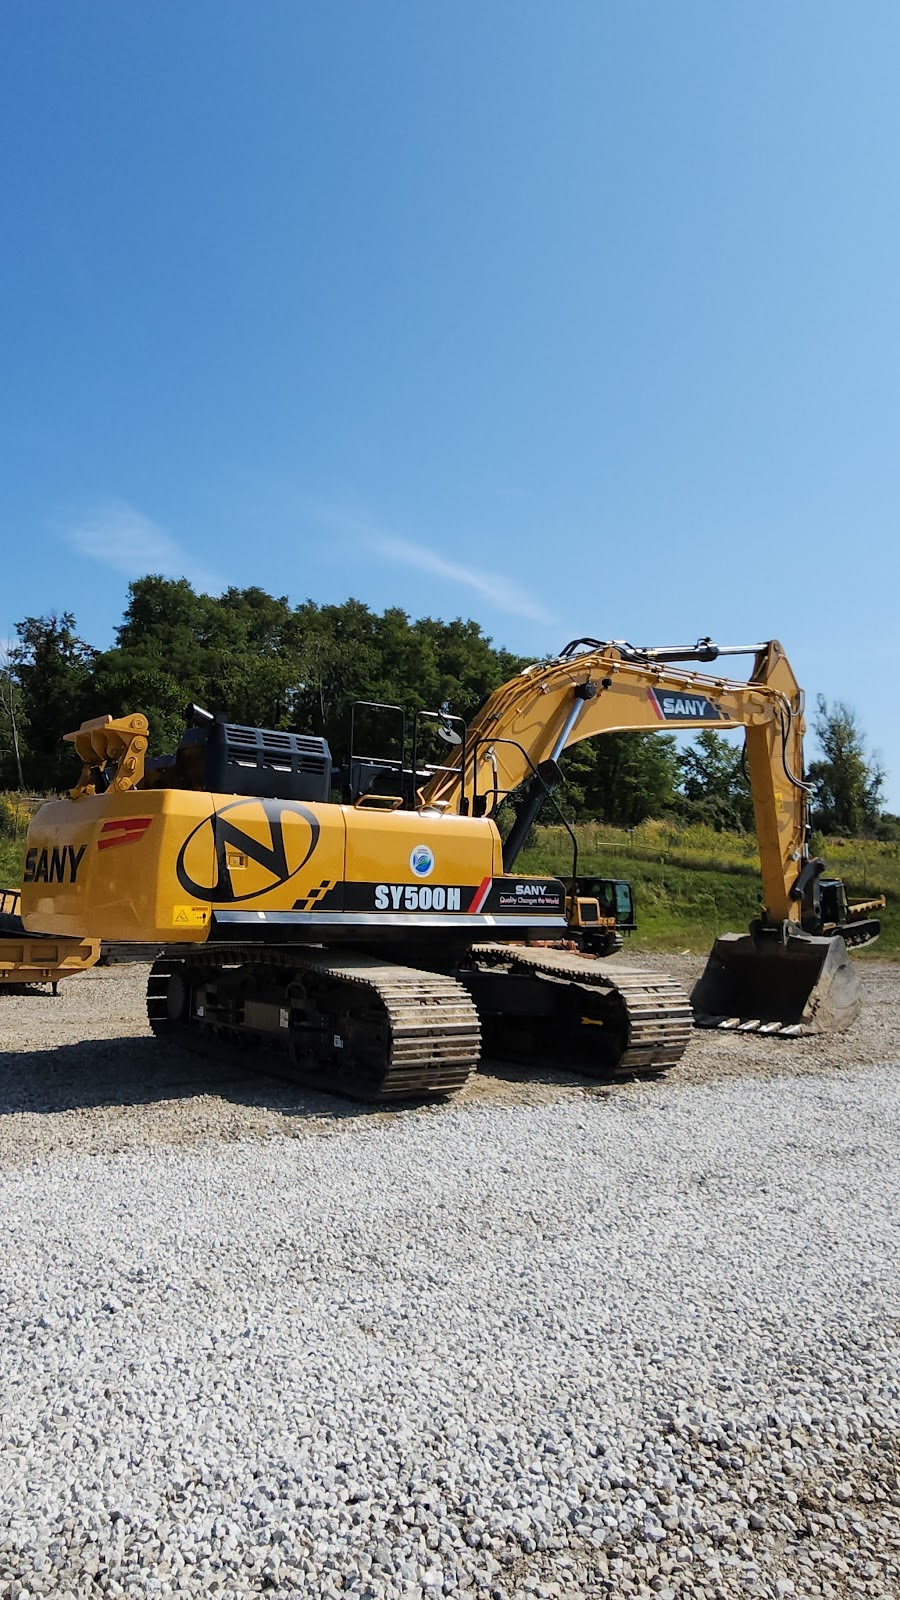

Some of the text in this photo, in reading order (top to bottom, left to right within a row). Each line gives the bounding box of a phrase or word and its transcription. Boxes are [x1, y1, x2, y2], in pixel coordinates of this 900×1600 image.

[663, 698, 707, 715] SANY
[23, 844, 88, 883] SANY
[374, 885, 461, 910] SY500H
[515, 885, 547, 895] SANY
[500, 895, 517, 904] Quality
[518, 897, 537, 905] Changes
